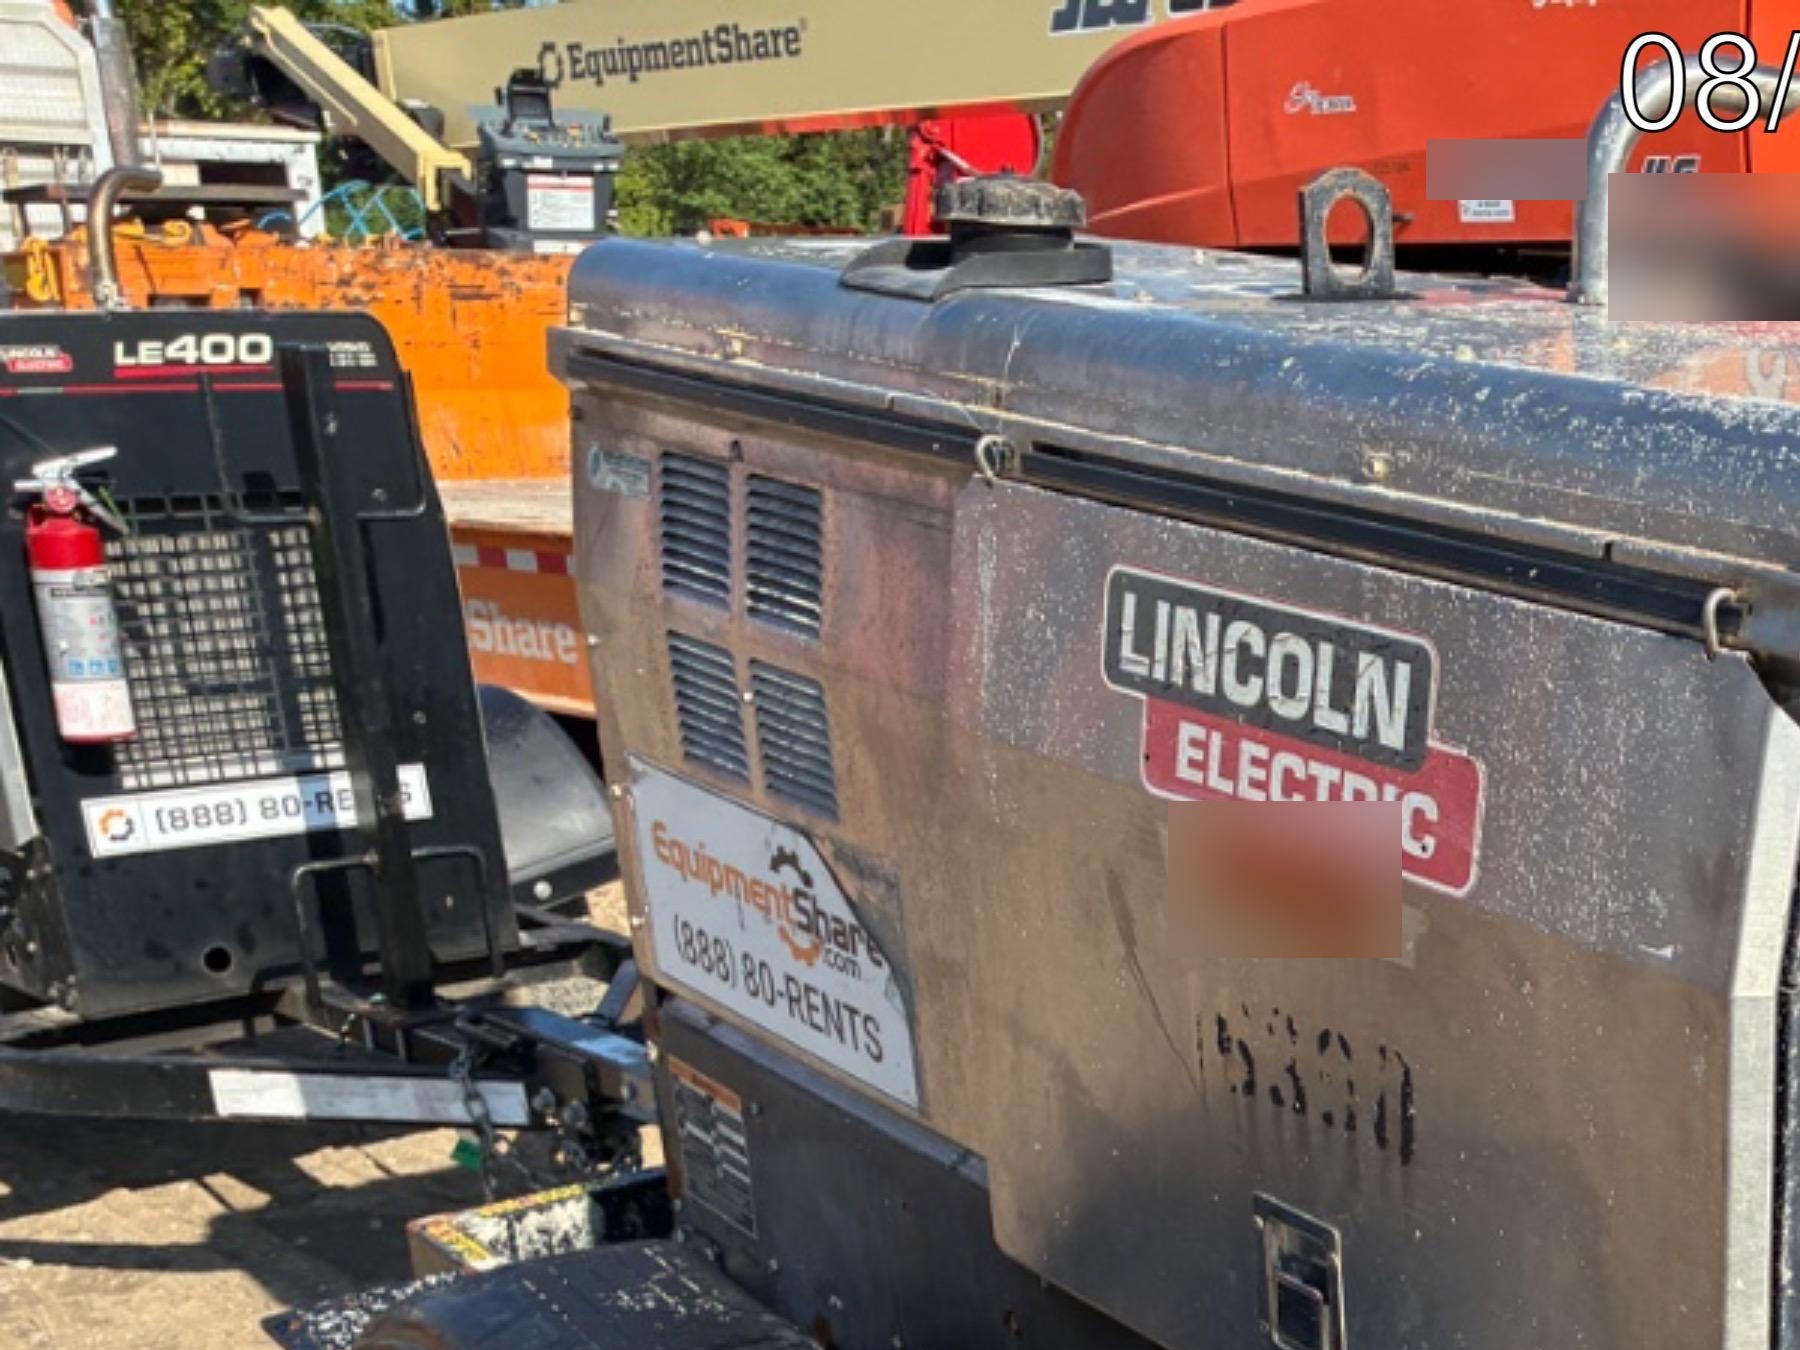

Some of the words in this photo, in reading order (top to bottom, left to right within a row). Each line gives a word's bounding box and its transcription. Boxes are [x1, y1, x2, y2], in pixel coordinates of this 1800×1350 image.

[566, 23, 802, 88] EquipmentShare
[114, 333, 274, 367] LE400
[1118, 591, 1412, 752] LINCOLN
[154, 798, 249, 835] (888)
[673, 914, 736, 990] (888)
[742, 951, 885, 1063] 80-RENTS
